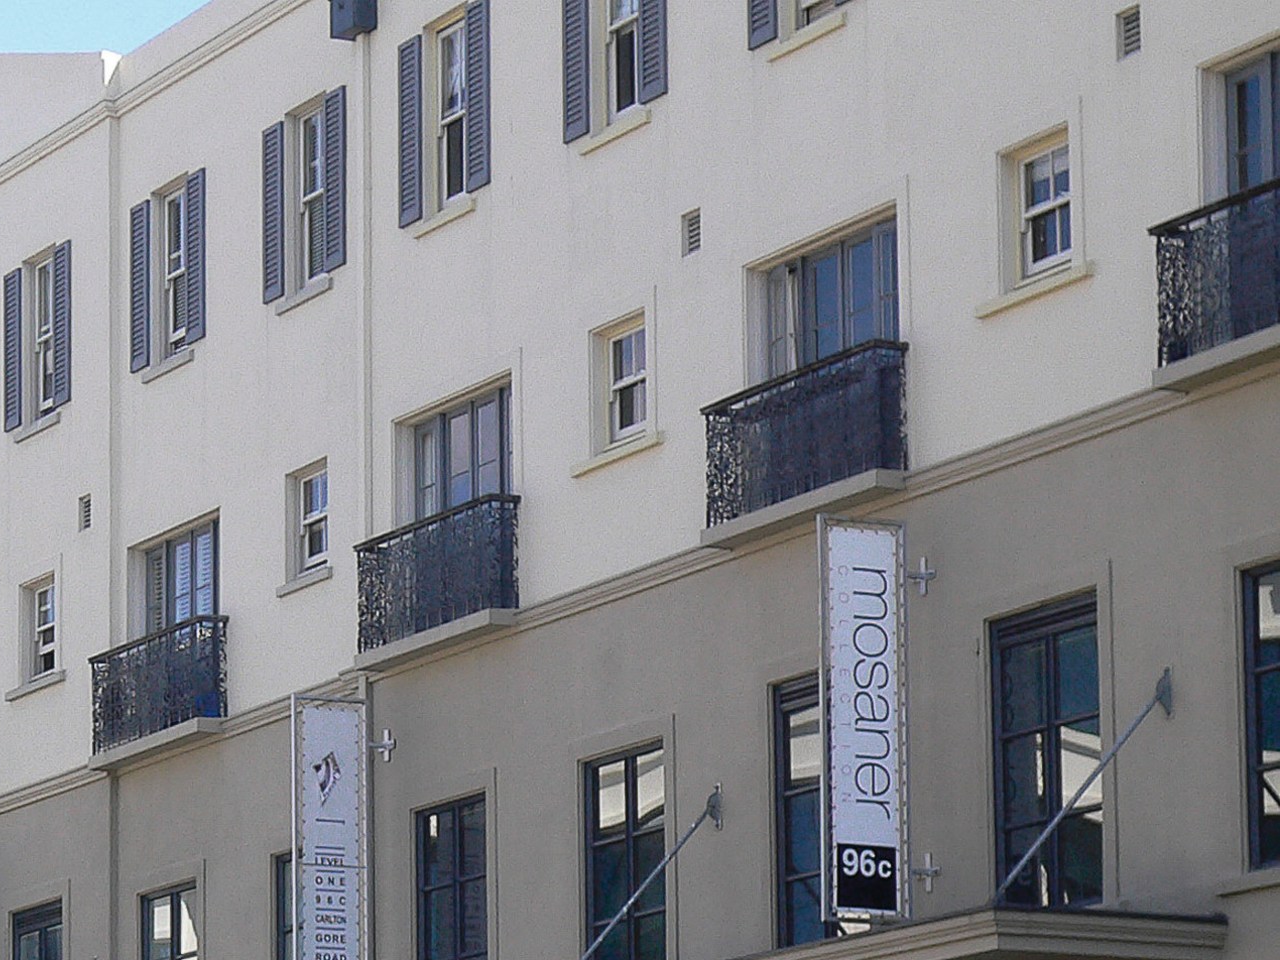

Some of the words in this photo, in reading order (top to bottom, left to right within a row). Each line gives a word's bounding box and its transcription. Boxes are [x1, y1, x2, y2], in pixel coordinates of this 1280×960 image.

[837, 564, 852, 803] COLLECTION
[852, 566, 892, 820] mosaner
[315, 857, 344, 867] LEVEL
[842, 848, 892, 878] 96c
[315, 876, 346, 887] ONE
[315, 914, 347, 925] CARLTON
[315, 934, 347, 945] GORE
